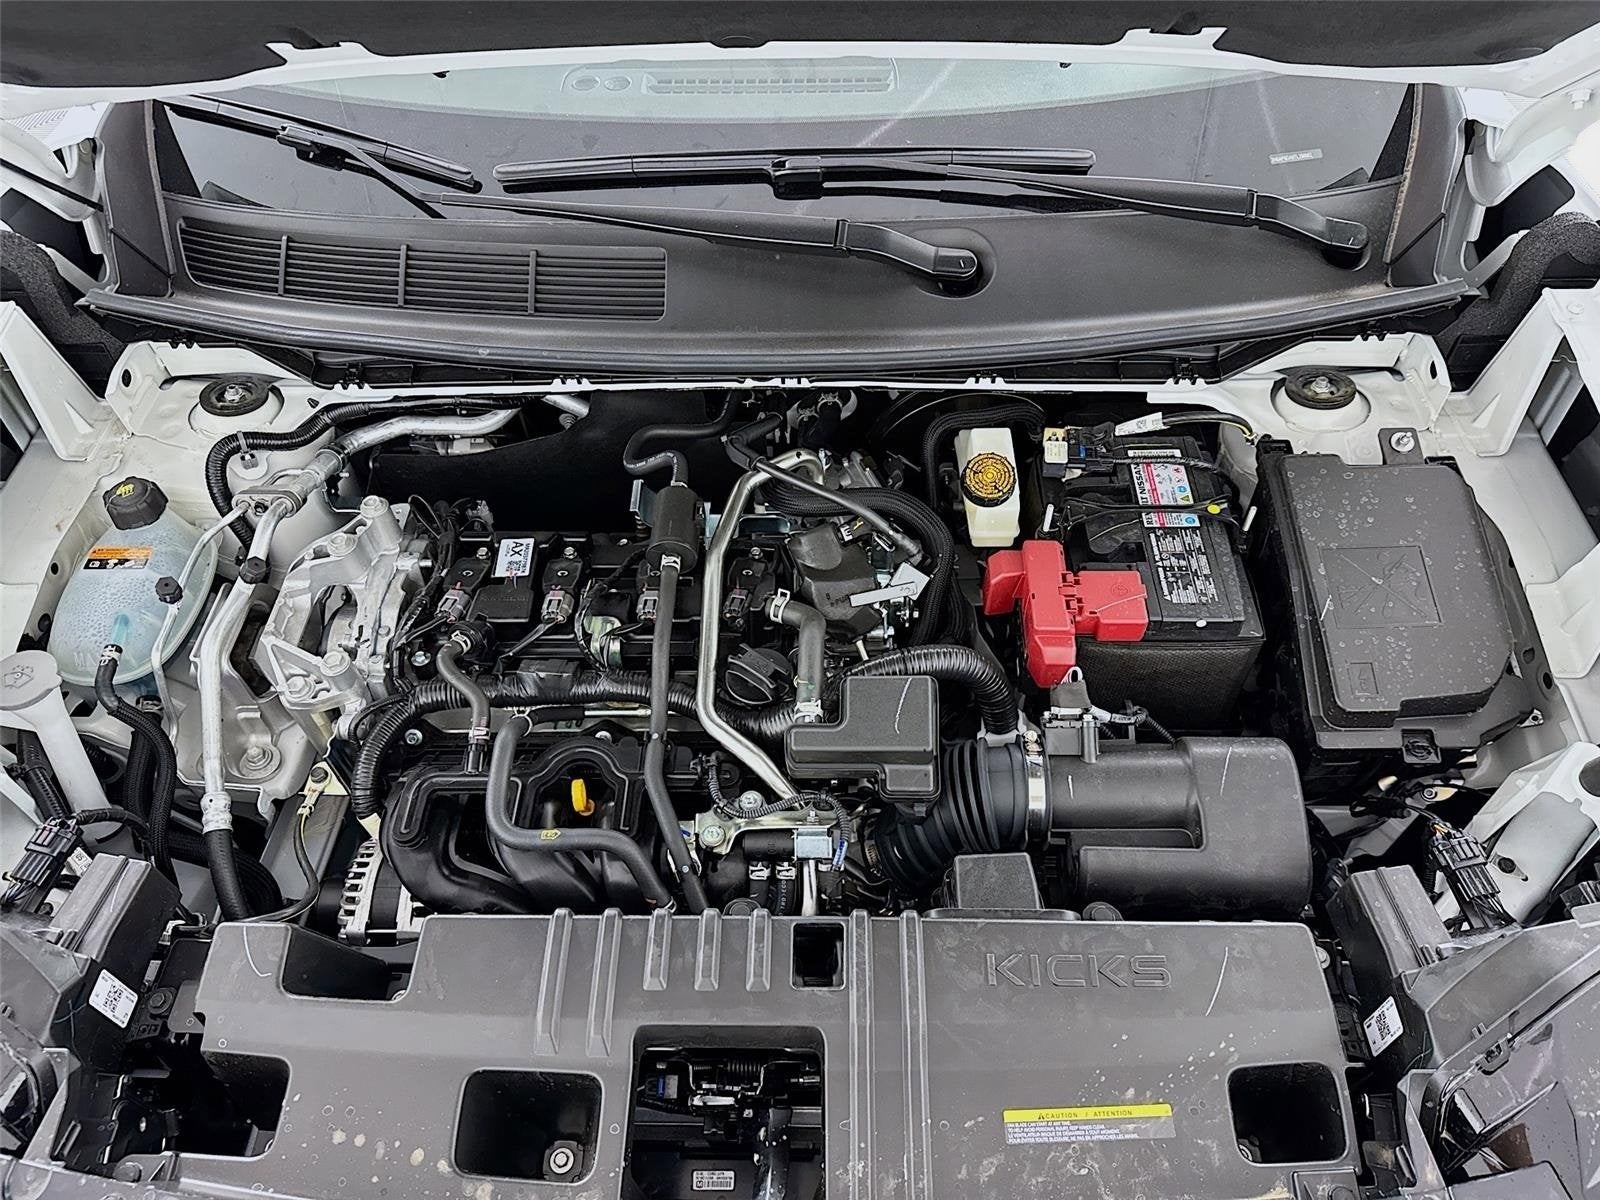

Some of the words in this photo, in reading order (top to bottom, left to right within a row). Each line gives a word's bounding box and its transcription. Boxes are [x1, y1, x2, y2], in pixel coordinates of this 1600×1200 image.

[1133, 462, 1146, 494] NISSAN
[510, 541, 524, 557] AX
[986, 953, 1171, 987] KICKS
[1093, 1109, 1132, 1117] ATTENTION
